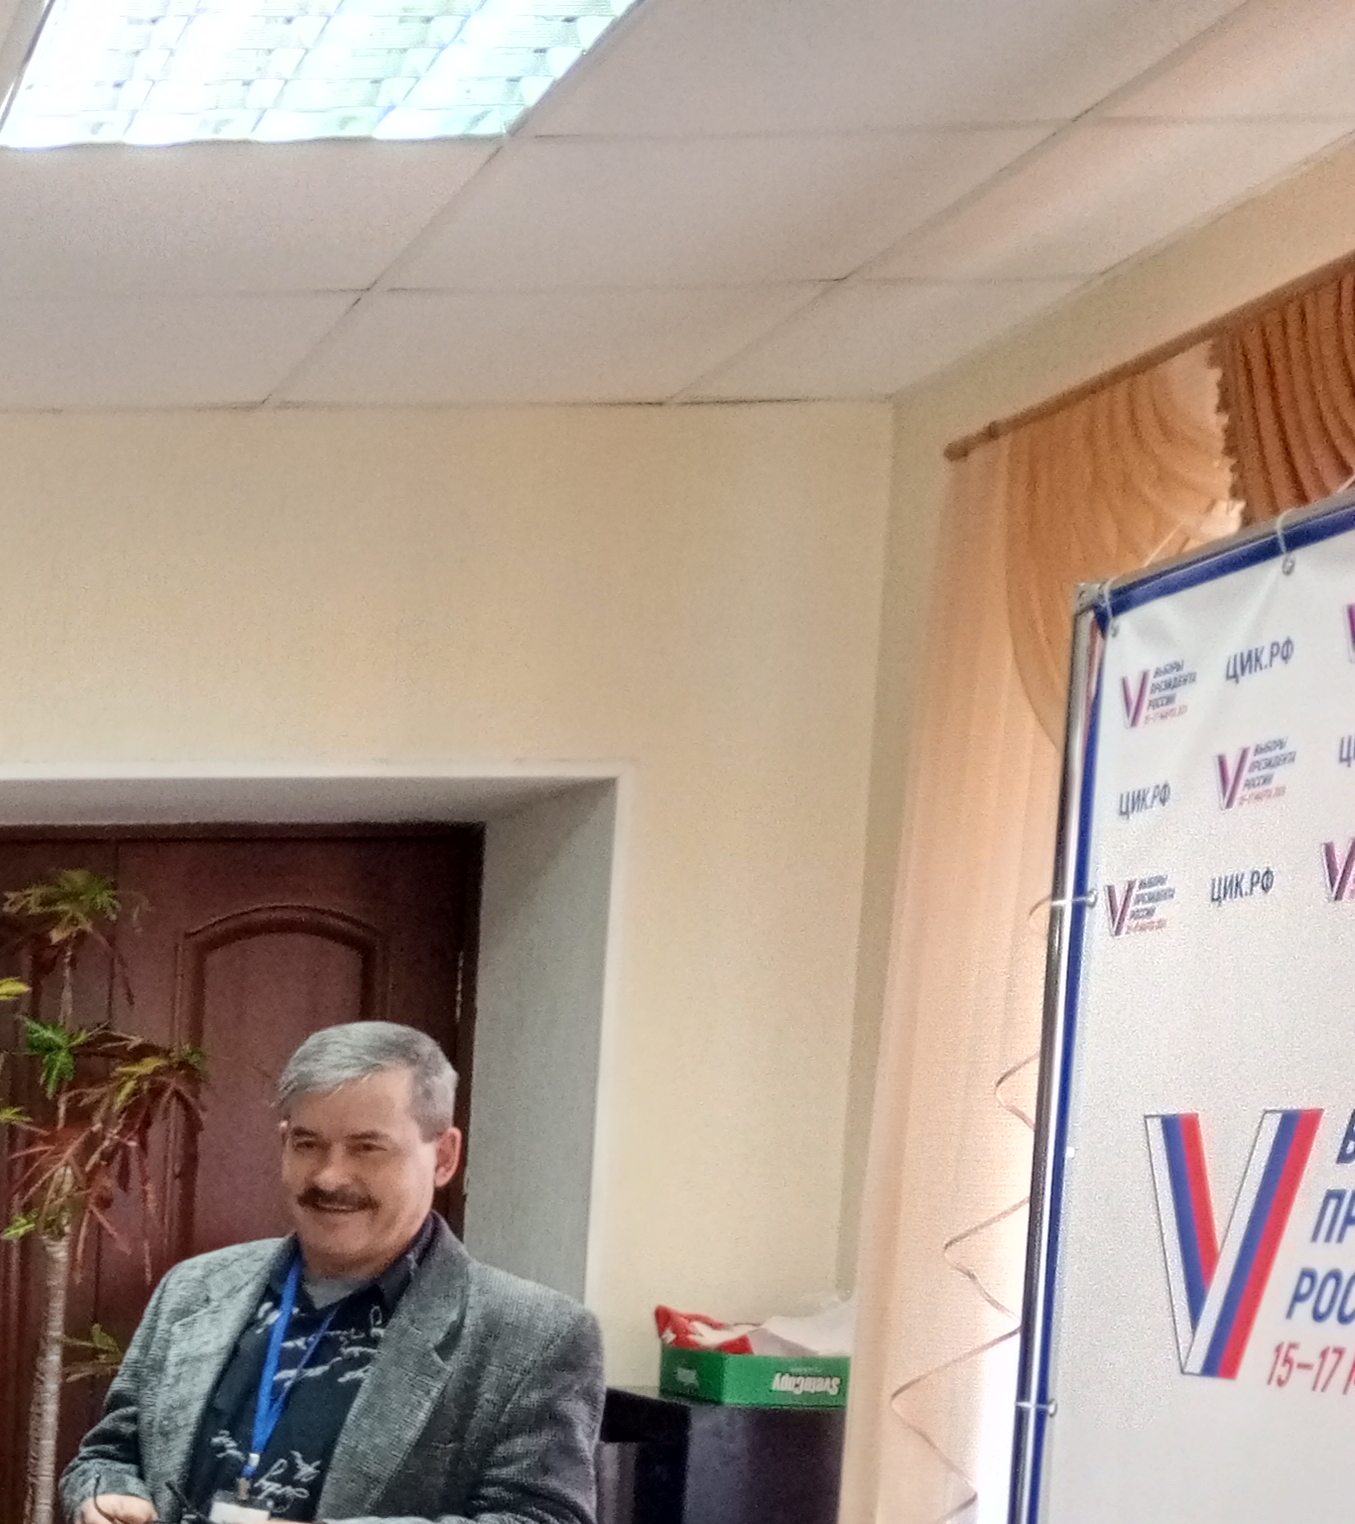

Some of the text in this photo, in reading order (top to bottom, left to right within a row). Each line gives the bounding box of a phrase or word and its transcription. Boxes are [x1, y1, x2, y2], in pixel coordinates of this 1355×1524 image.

[1225, 636, 1294, 684] ЦИК.РФ
[1338, 736, 1355, 767] Ц
[1118, 782, 1171, 820] ЦИК.РФ
[1209, 867, 1275, 907] ЦИК.РФ
[772, 1371, 841, 1396] SvetoCopy
